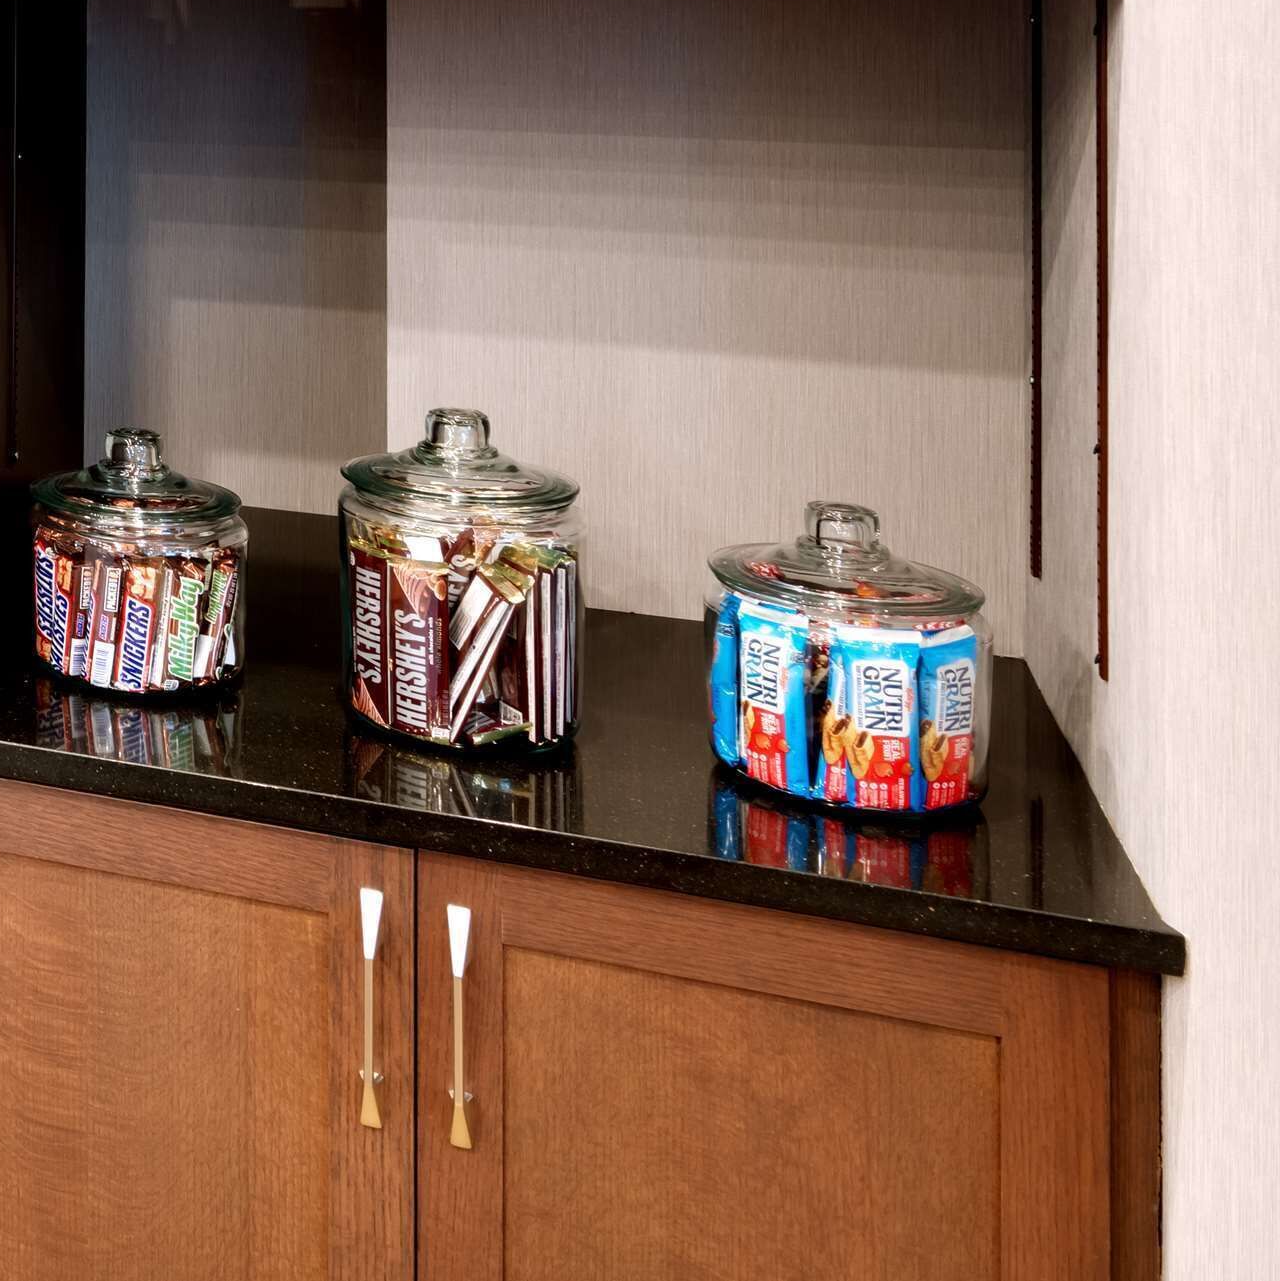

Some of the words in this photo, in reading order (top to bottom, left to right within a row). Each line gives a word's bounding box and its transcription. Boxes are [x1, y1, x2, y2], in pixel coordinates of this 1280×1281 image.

[120, 600, 151, 689] SNICKERS
[355, 567, 382, 684] HERSHEY'S
[394, 610, 428, 728] HERSHEY'S
[747, 638, 765, 707] GRAIN
[761, 642, 782, 709] NUTRI
[863, 664, 887, 732] GRAIN
[880, 666, 903, 733] NUTRI
[943, 667, 959, 732] GRAIN
[955, 666, 971, 730] NUTRI
